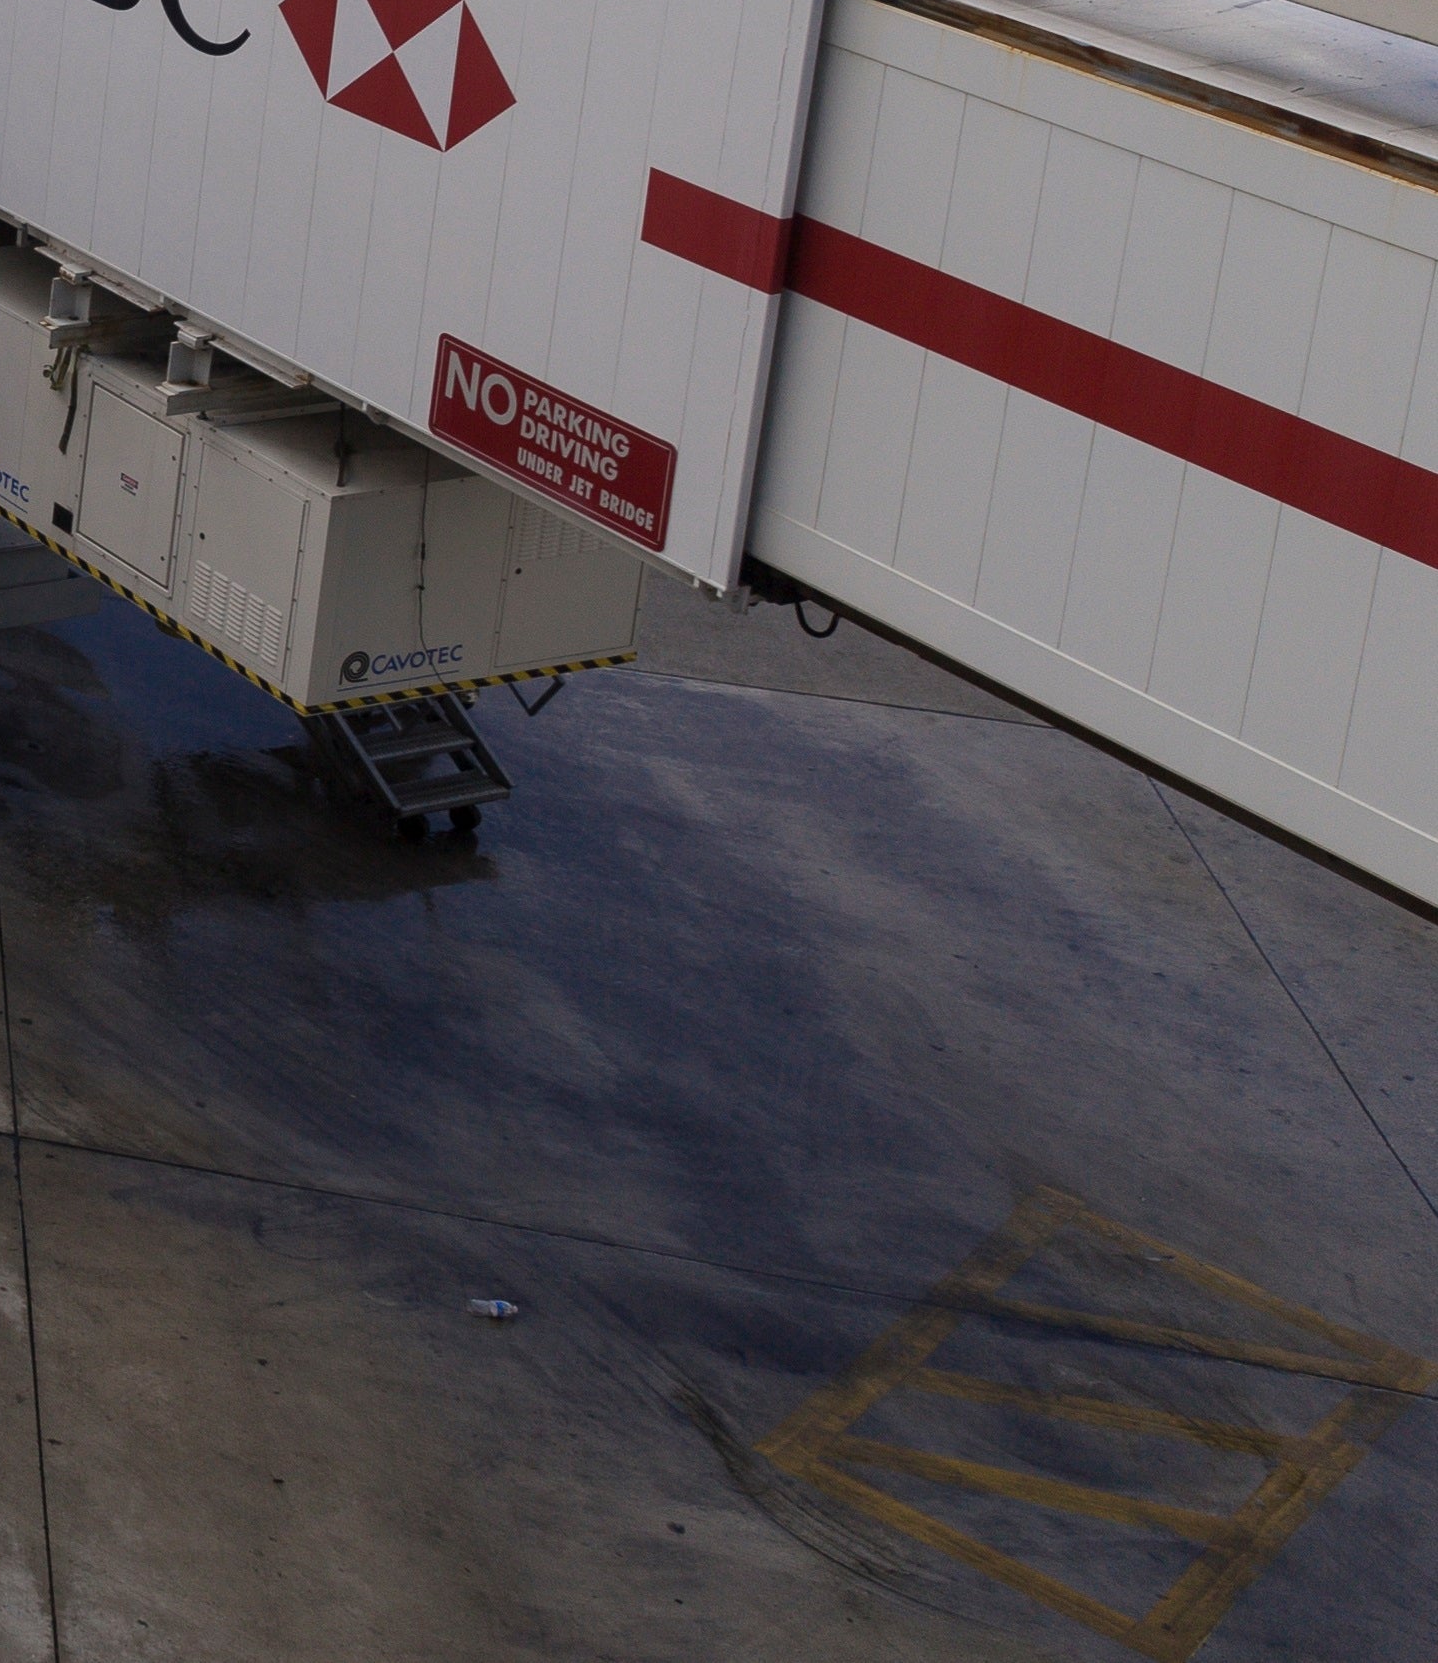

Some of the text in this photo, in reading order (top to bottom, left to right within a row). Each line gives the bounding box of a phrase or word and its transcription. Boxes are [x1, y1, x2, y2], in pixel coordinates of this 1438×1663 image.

[444, 349, 518, 426] NO
[520, 414, 619, 482] DRIVING
[523, 388, 630, 459] PARKING
[516, 447, 655, 532] UNDER JET BRIDGE
[371, 644, 463, 675] CAVOTEC
